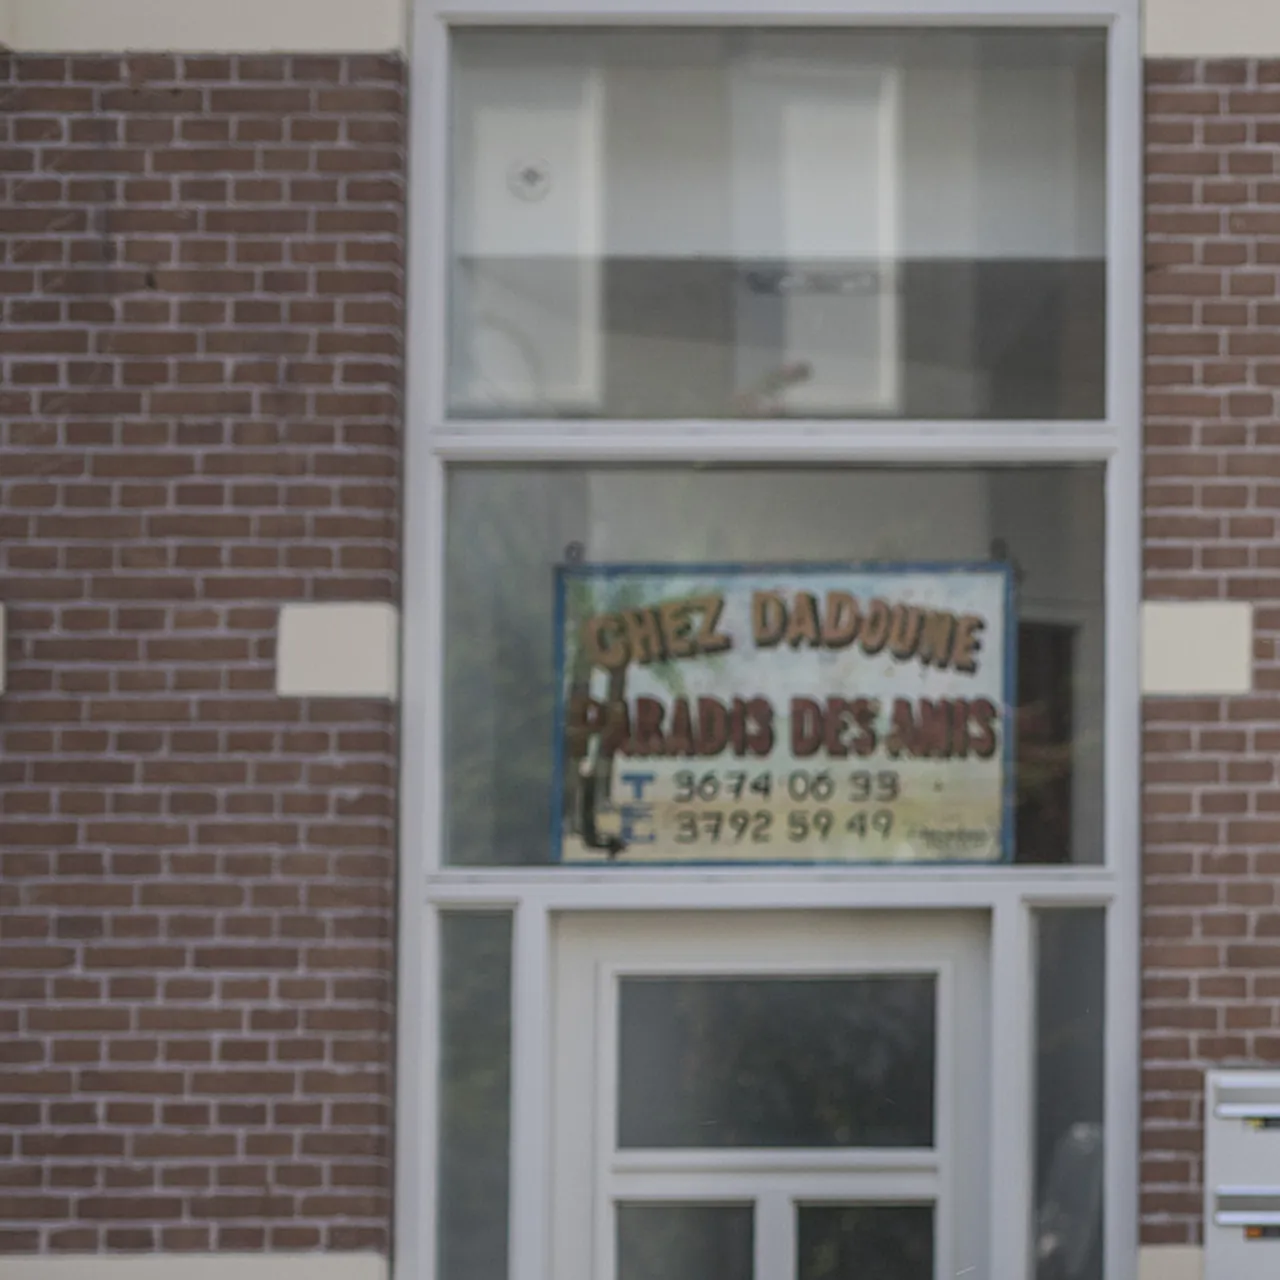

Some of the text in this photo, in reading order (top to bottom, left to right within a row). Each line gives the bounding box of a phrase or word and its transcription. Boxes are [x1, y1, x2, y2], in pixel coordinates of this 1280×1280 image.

[585, 596, 733, 669] CHEZ
[570, 693, 998, 761] PARADIS DES AMIS
[788, 807, 835, 844] 59
